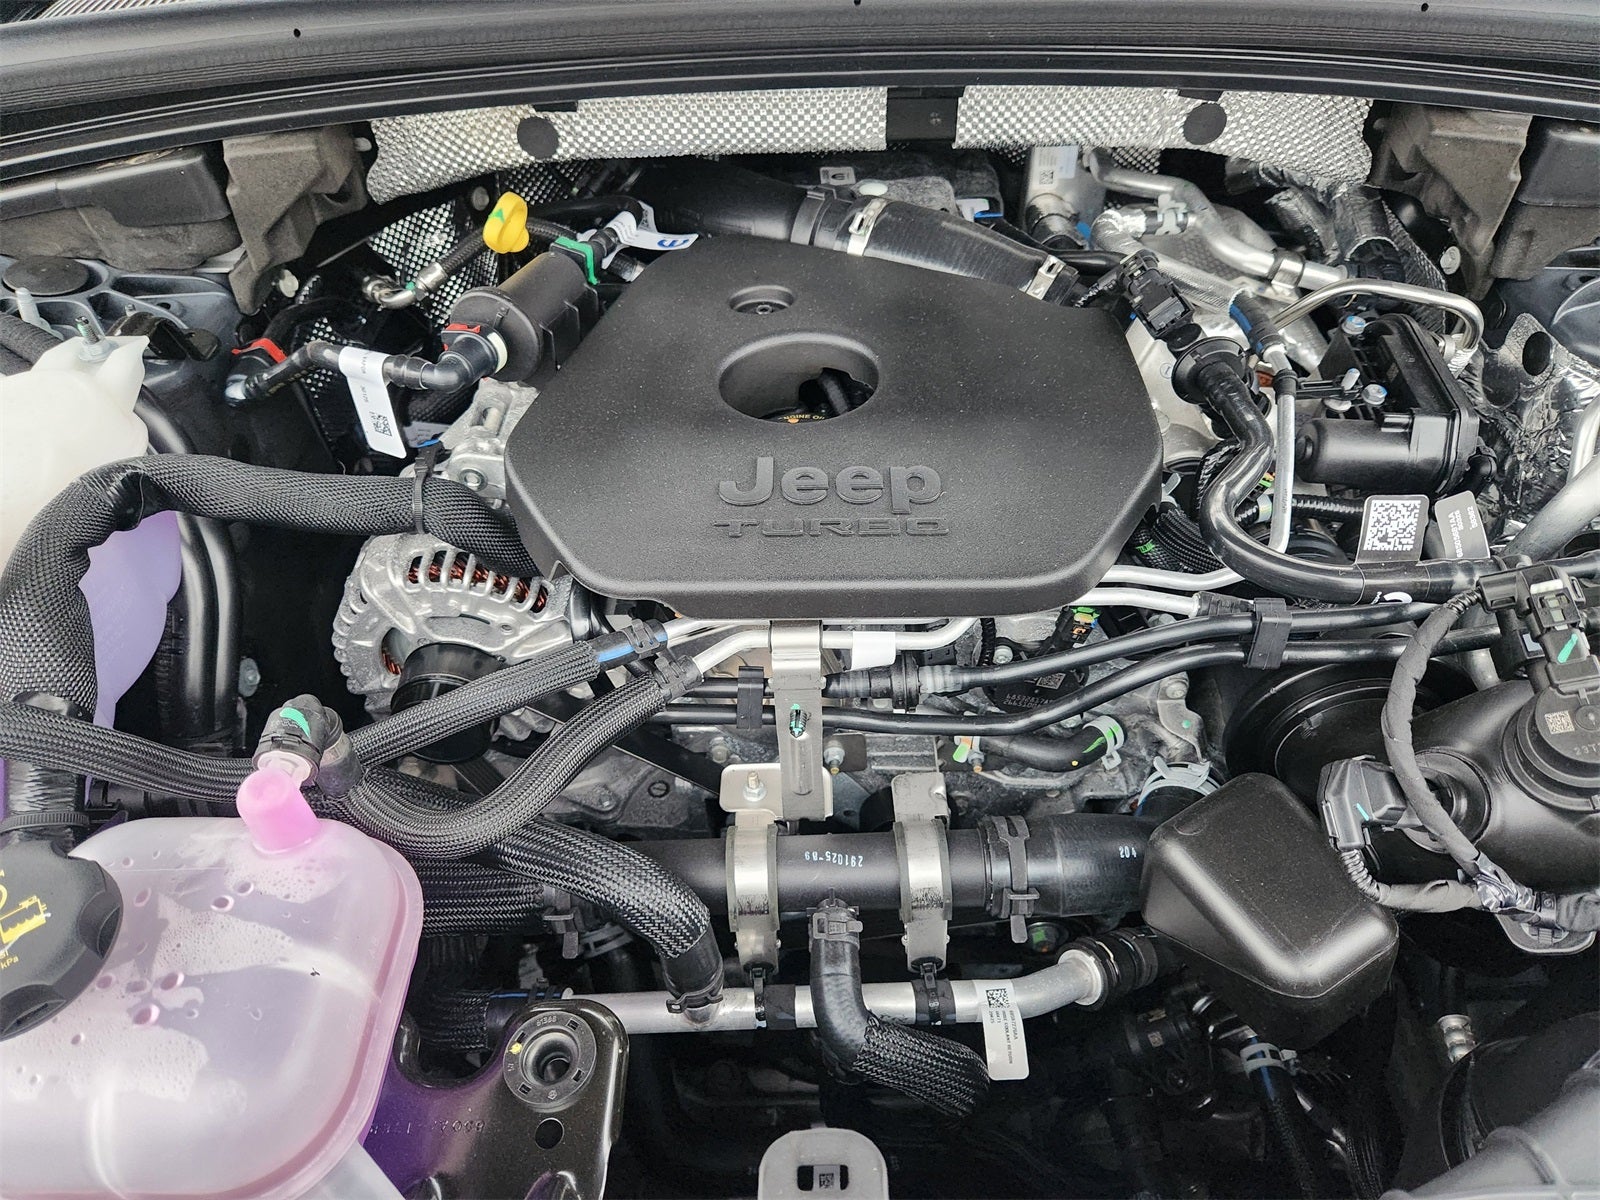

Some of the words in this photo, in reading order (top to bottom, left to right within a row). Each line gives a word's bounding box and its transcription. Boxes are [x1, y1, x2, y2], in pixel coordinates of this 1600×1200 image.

[718, 456, 942, 515] Jeep
[713, 517, 950, 538] TURBO
[0, 955, 19, 970] kPa
